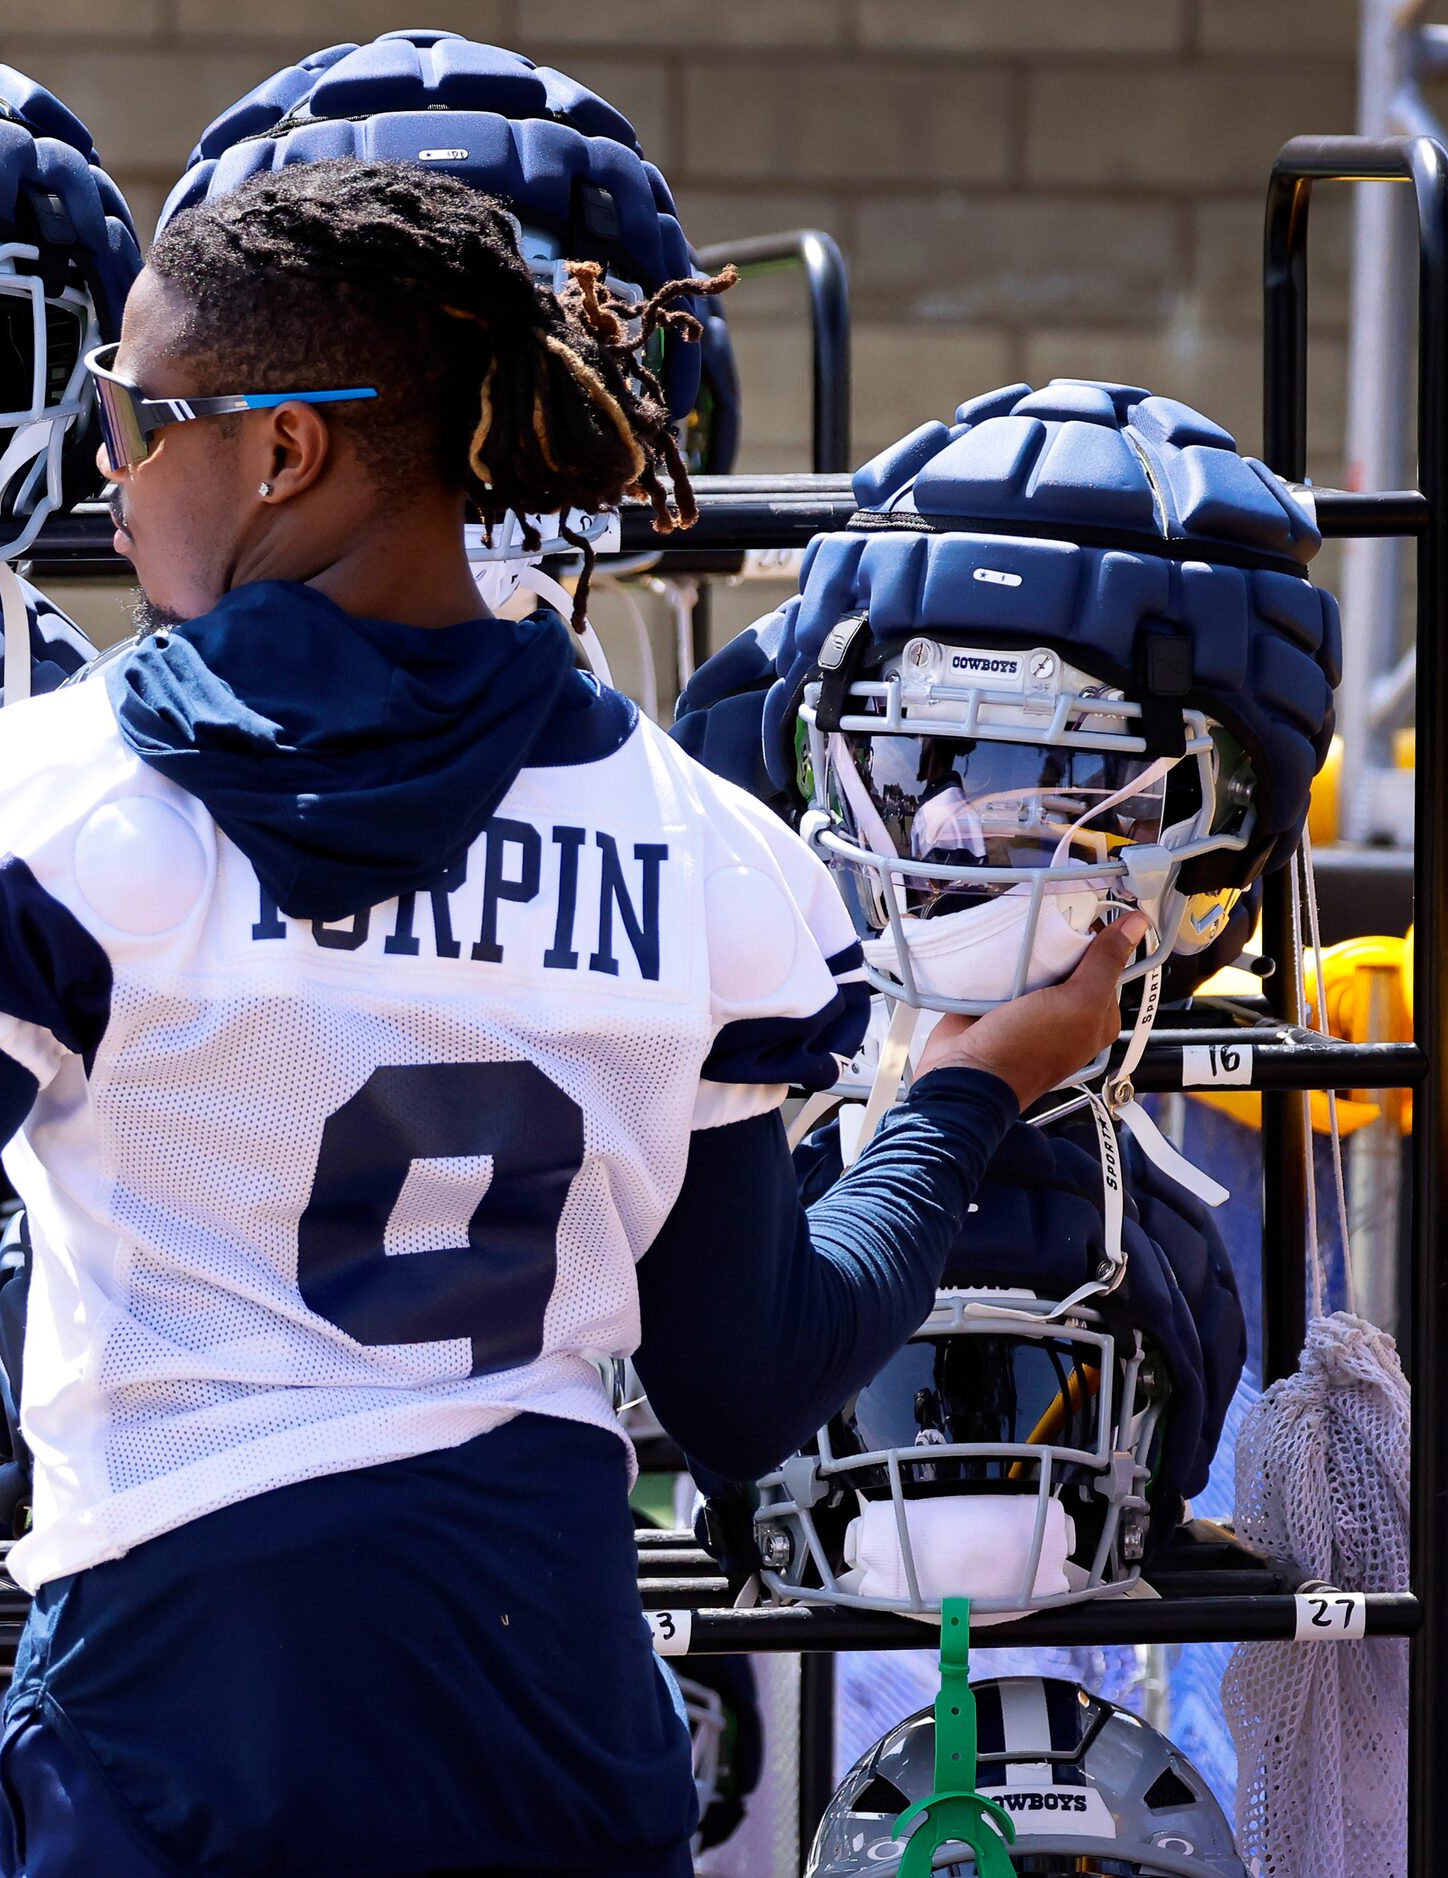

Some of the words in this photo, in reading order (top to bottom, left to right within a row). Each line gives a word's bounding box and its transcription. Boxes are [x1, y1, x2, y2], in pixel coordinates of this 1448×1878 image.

[952, 655, 1018, 674] COWBOYS
[1142, 970, 1160, 1025] SPORT
[1208, 1044, 1241, 1078] 16
[1103, 1131, 1119, 1191] SPORT
[297, 1059, 585, 1377] 9
[1308, 1598, 1356, 1630] 27
[990, 1792, 1088, 1812] OWBOYS
